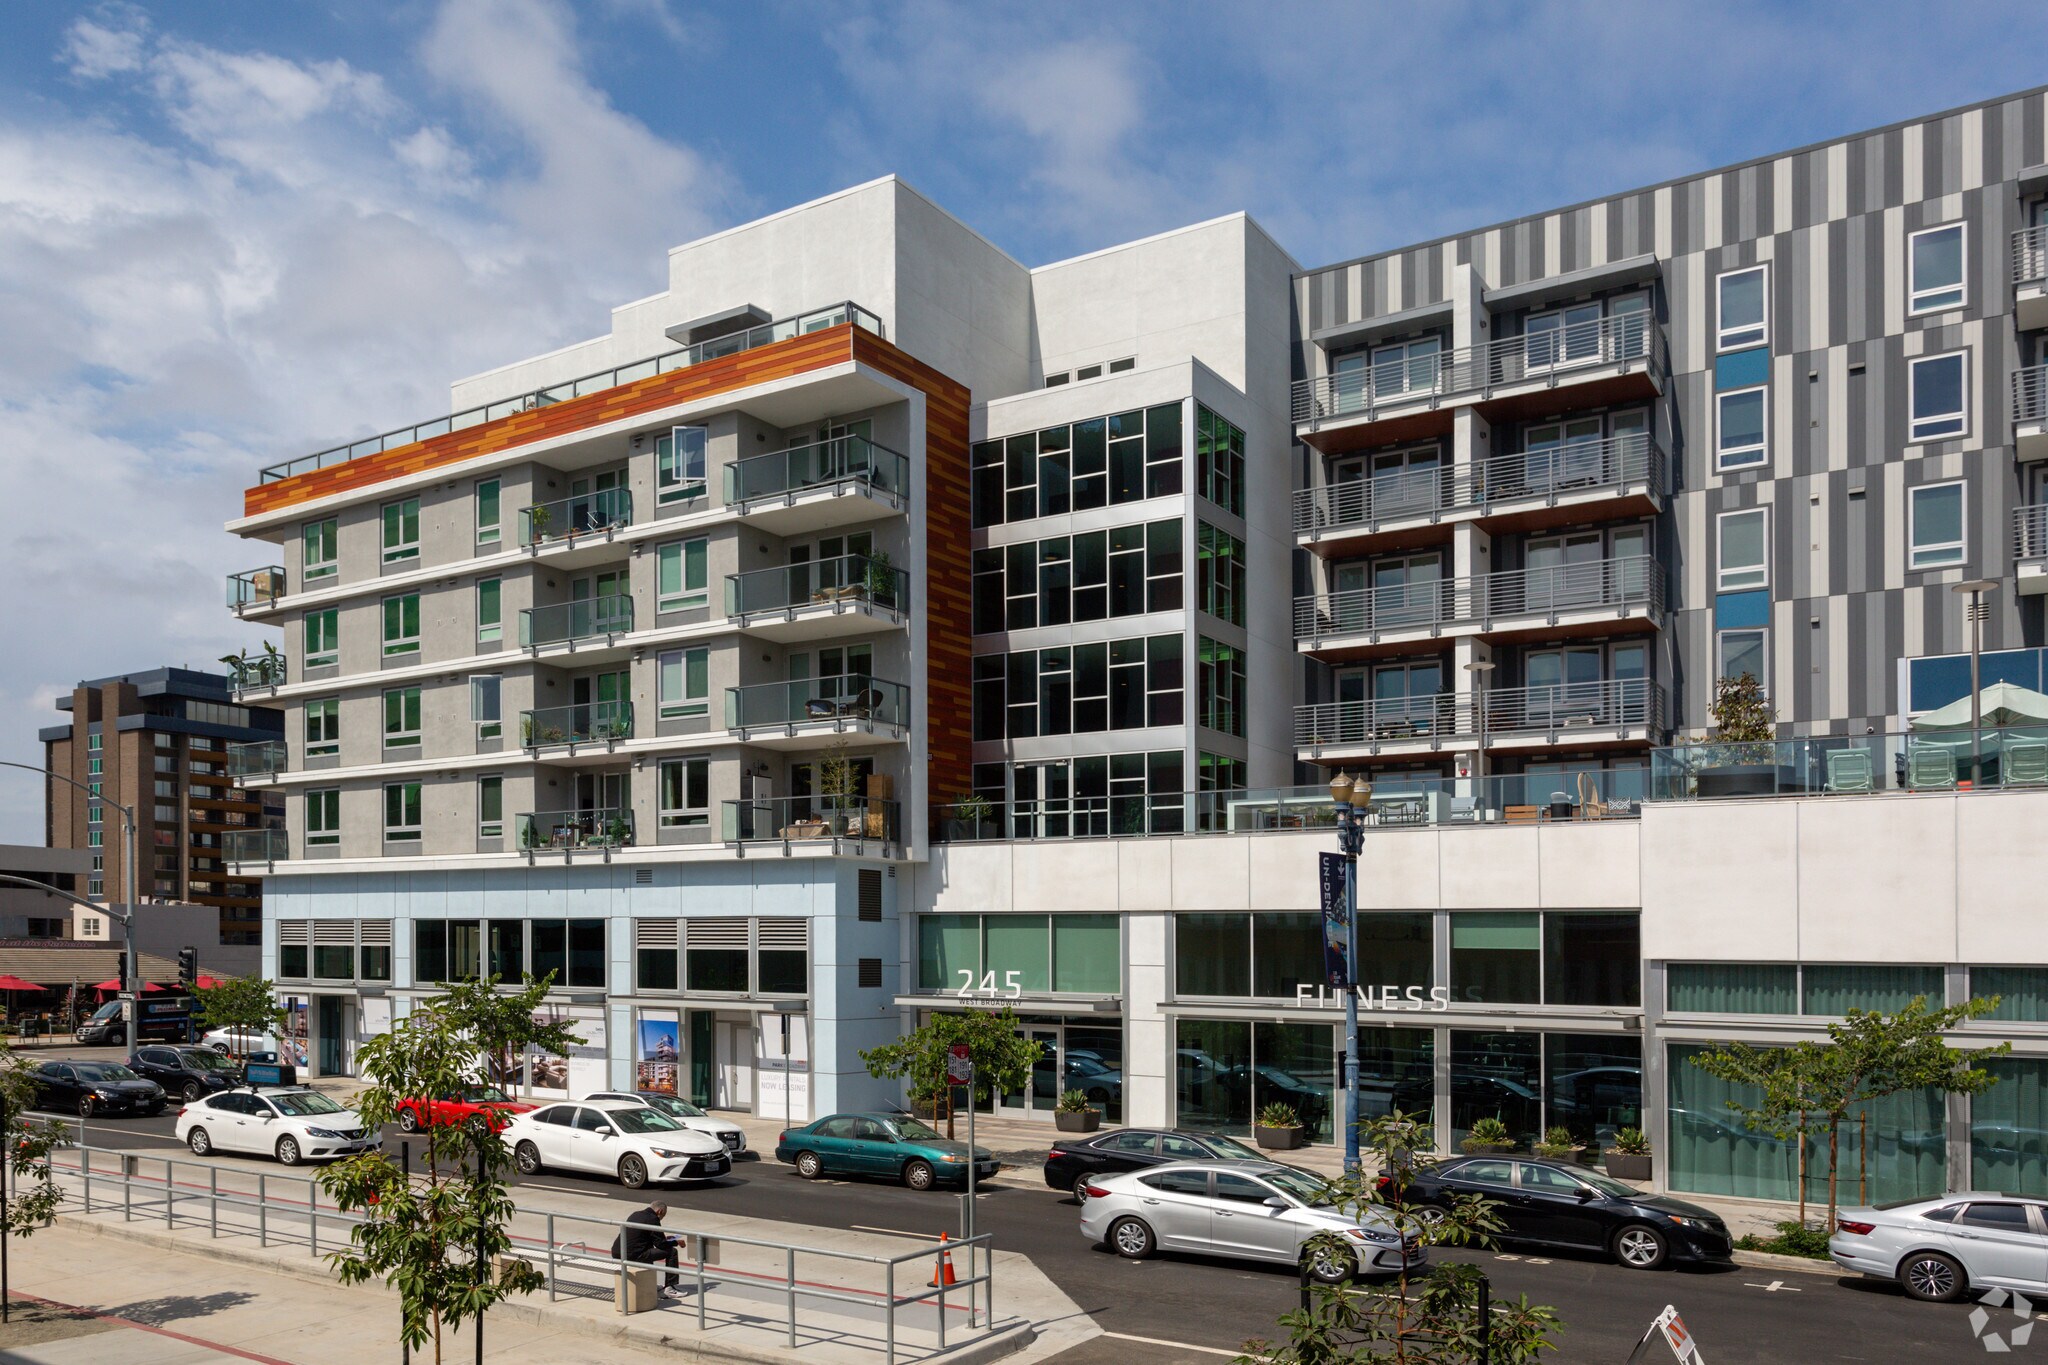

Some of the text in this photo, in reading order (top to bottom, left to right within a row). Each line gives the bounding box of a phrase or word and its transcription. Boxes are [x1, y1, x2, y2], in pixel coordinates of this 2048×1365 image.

[957, 969, 1021, 999] 245
[980, 999, 1022, 1007] BROADWAY
[761, 1082, 806, 1092] NOW LESING
